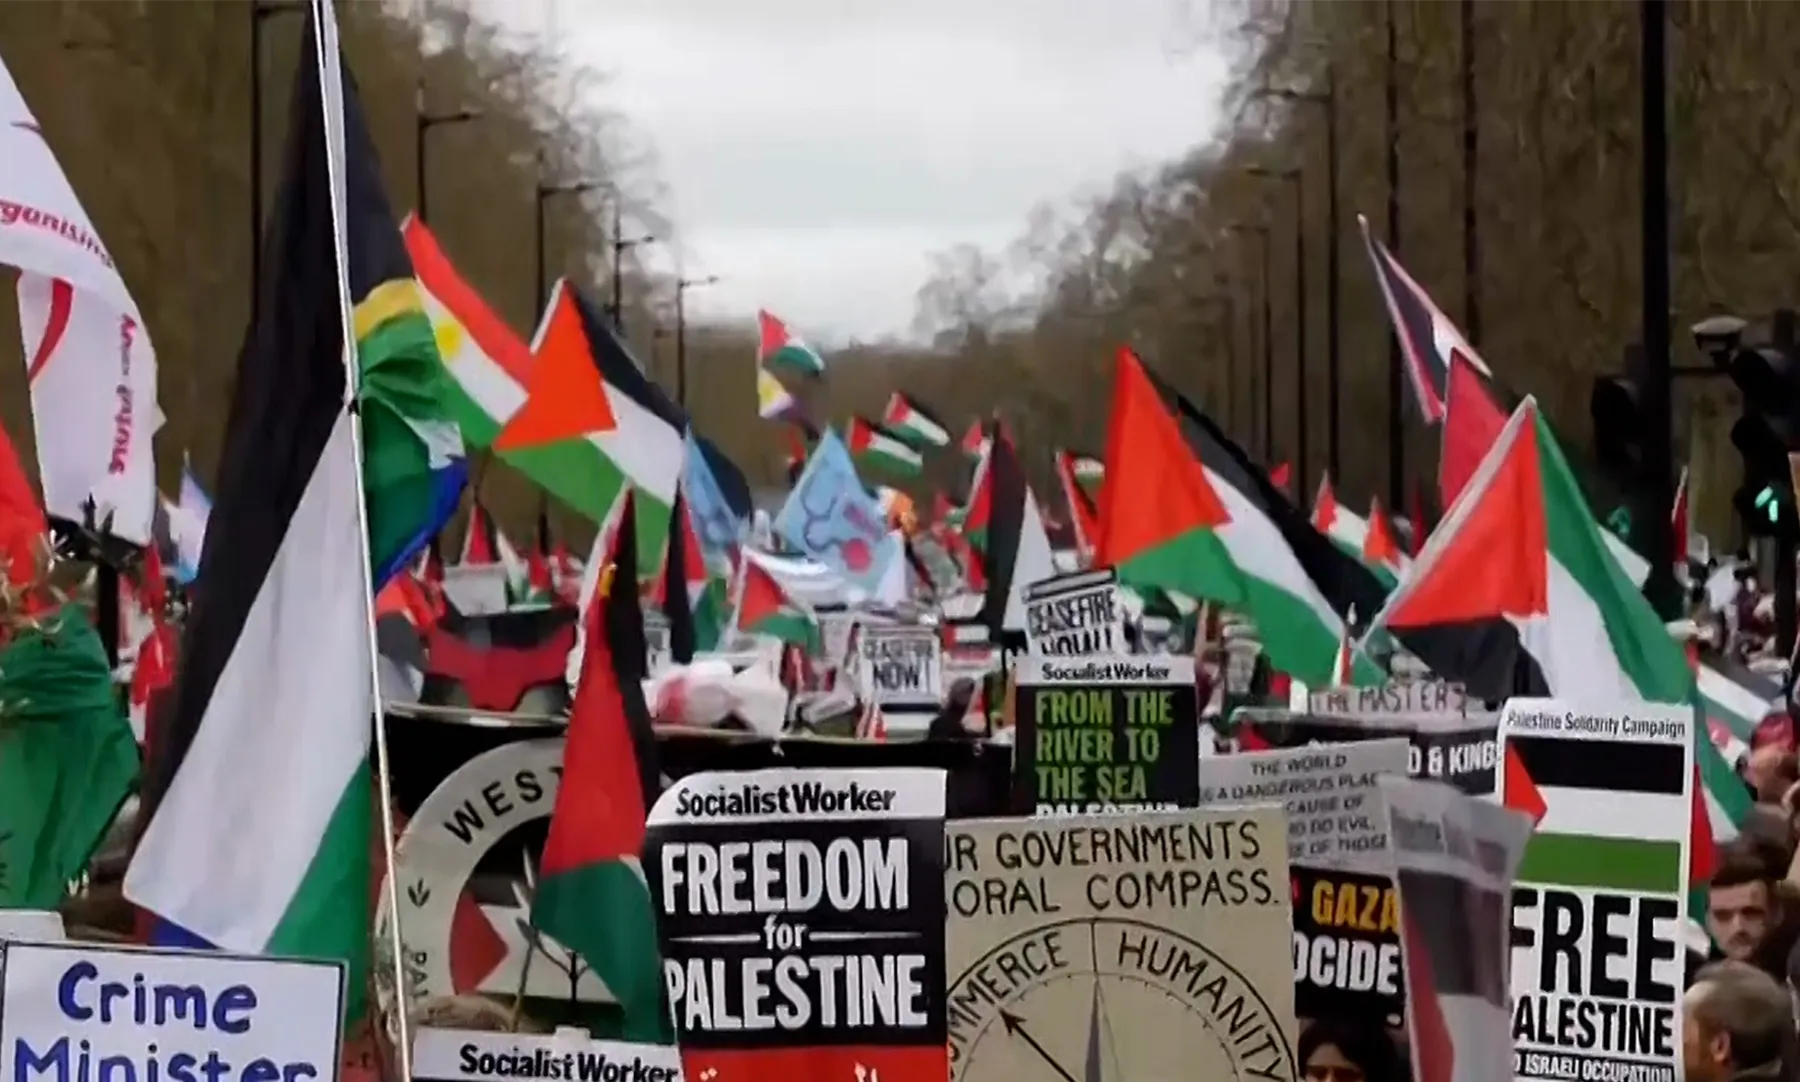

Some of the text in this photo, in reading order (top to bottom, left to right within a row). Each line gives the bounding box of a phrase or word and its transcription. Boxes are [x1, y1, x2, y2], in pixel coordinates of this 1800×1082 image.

[1035, 691, 1174, 725] FROM THE
[1507, 709, 1685, 739] Palestine Solidarity Campaign
[1035, 728, 1160, 762] RIVER TO
[1428, 747, 1443, 776] &
[1035, 766, 1147, 800] THE SEA
[1251, 755, 1346, 776] THE WORLD
[676, 782, 896, 816] Socialist Worker
[1217, 787, 1228, 800] A
[1232, 777, 1335, 800] DANGEROUS
[1338, 773, 1380, 788] PLAC
[1287, 796, 1338, 814] CAUSE
[996, 821, 1260, 869] GOVERNMENTS
[661, 838, 909, 916] FREEDOM
[953, 877, 1061, 917] ORAL
[1312, 880, 1398, 933] GAZA
[763, 914, 808, 950] for
[1510, 887, 1679, 1003] FREE
[1294, 931, 1399, 994] OCIDE
[58, 960, 257, 1033] Crime
[664, 955, 928, 1031] PALESTINE
[1119, 930, 1286, 1082] HUMANITY
[1512, 996, 1674, 1055] ALESTINE
[15, 1036, 317, 1082] Minister
[459, 1043, 679, 1082] Socialist Worker
[1525, 1054, 1579, 1078] ISRAELI
[1582, 1059, 1673, 1082] OCCUPATION
